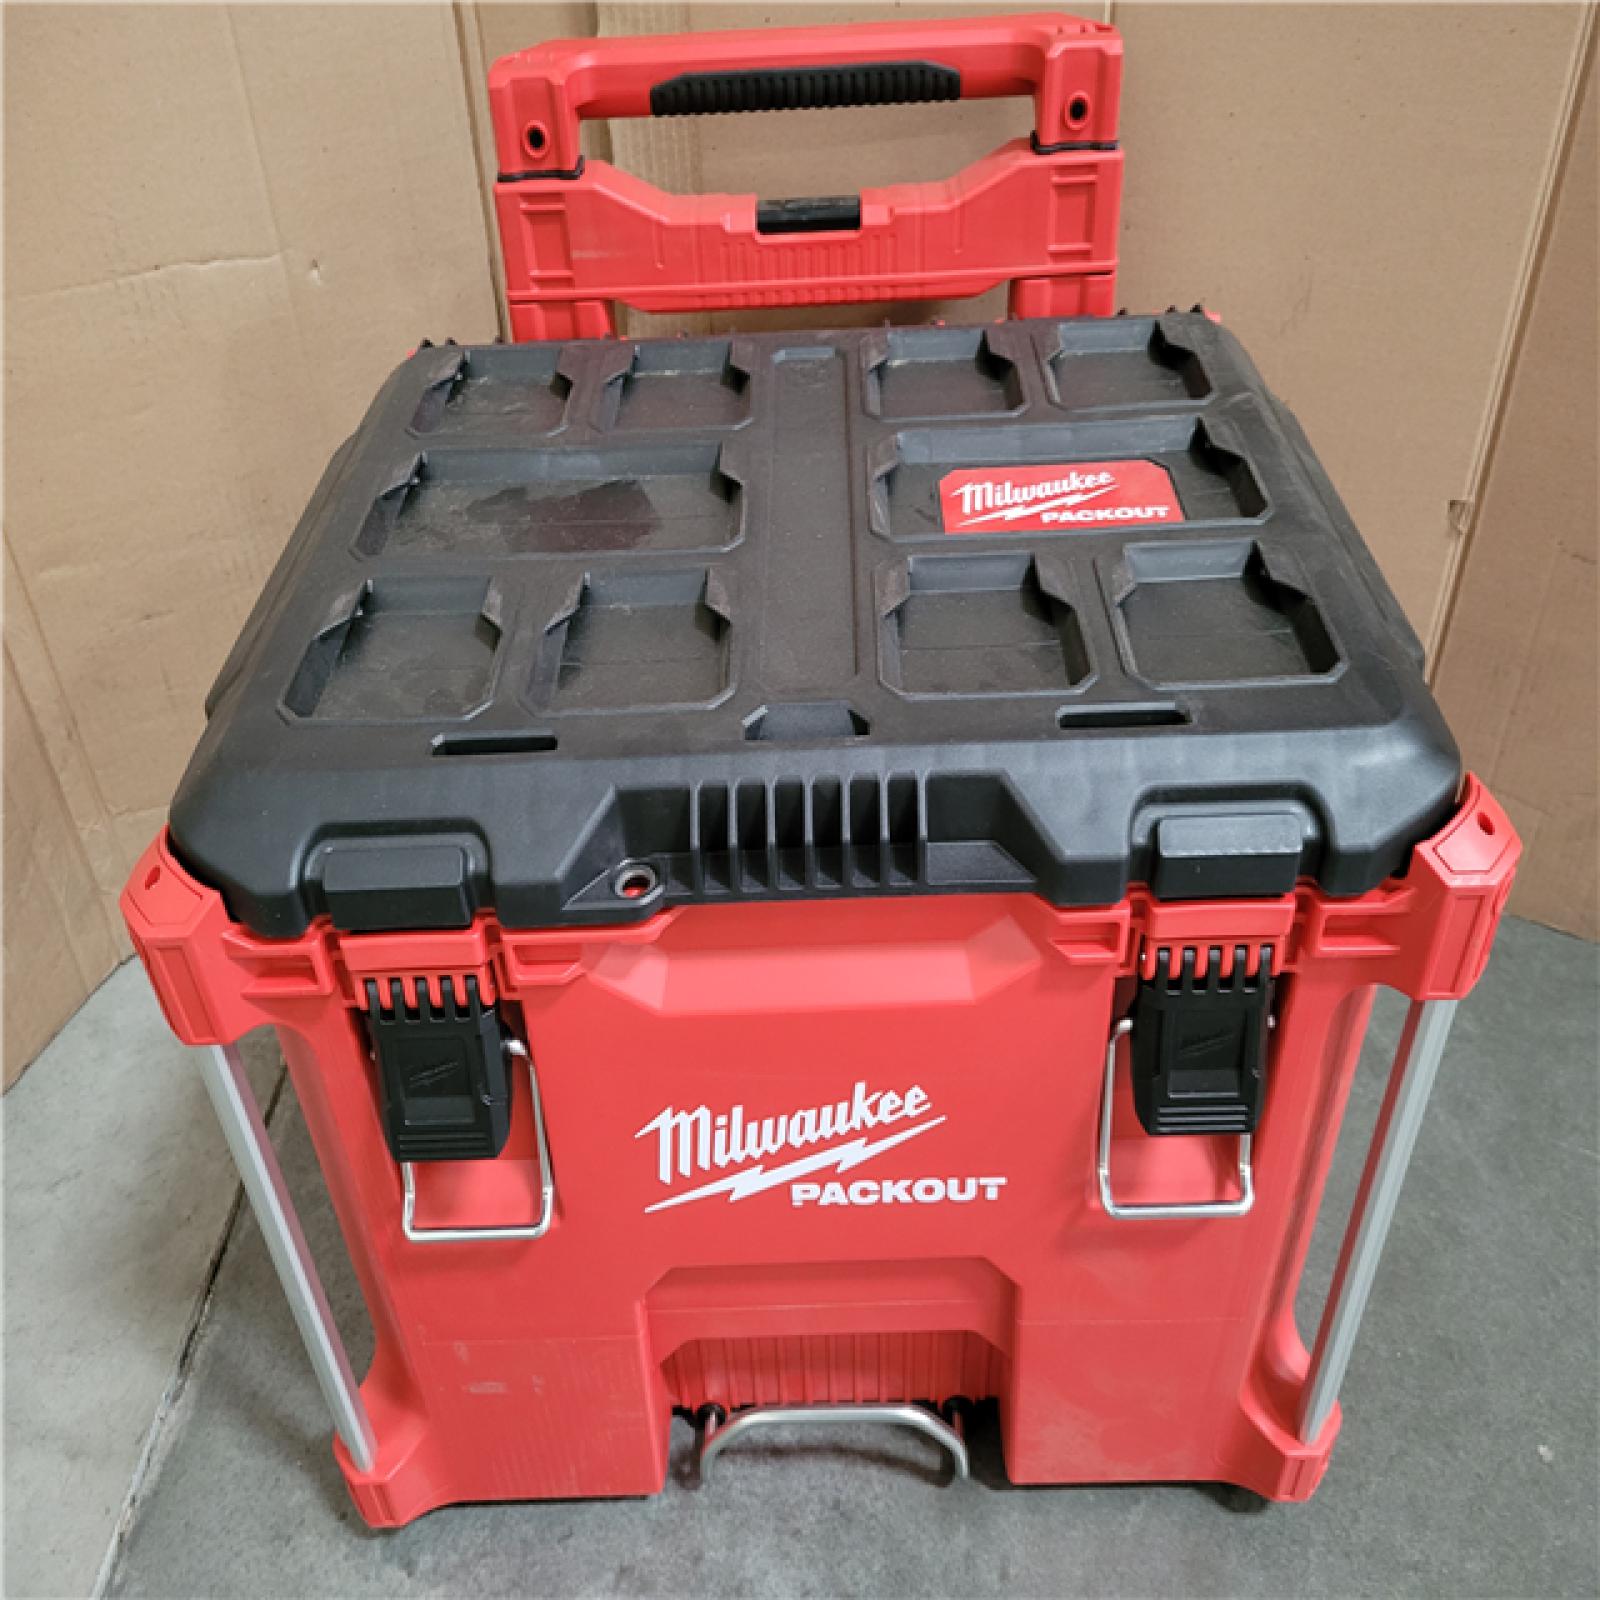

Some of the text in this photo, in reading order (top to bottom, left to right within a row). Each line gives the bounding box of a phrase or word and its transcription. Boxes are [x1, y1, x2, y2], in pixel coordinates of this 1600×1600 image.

[951, 471, 1115, 514] Milwaukee
[1040, 505, 1171, 523] PACKOUT
[634, 1081, 932, 1185] Milwaukee
[791, 1176, 1008, 1207] PACKOUT
